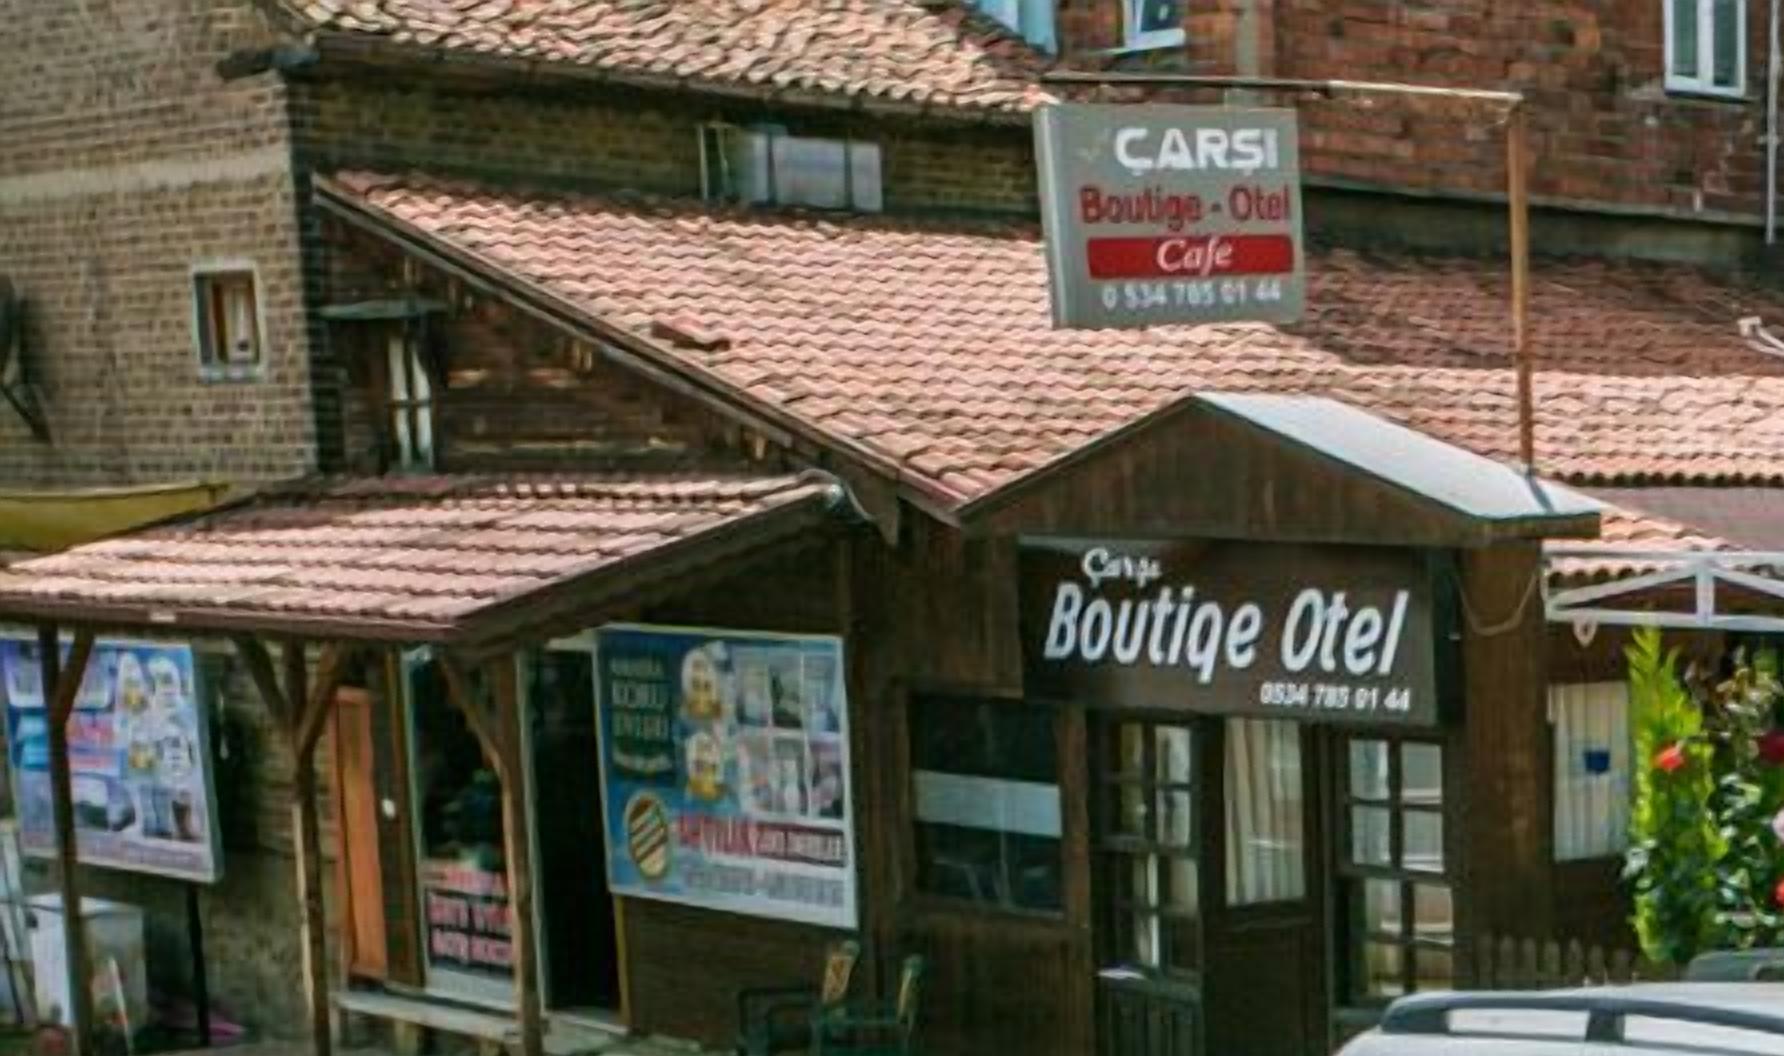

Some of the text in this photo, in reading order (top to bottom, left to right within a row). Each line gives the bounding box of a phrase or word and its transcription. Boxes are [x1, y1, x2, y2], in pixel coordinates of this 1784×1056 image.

[1229, 183, 1291, 222] Otel
[1156, 235, 1234, 276] Cafe
[1044, 581, 1410, 684] Boutiqe Otel
